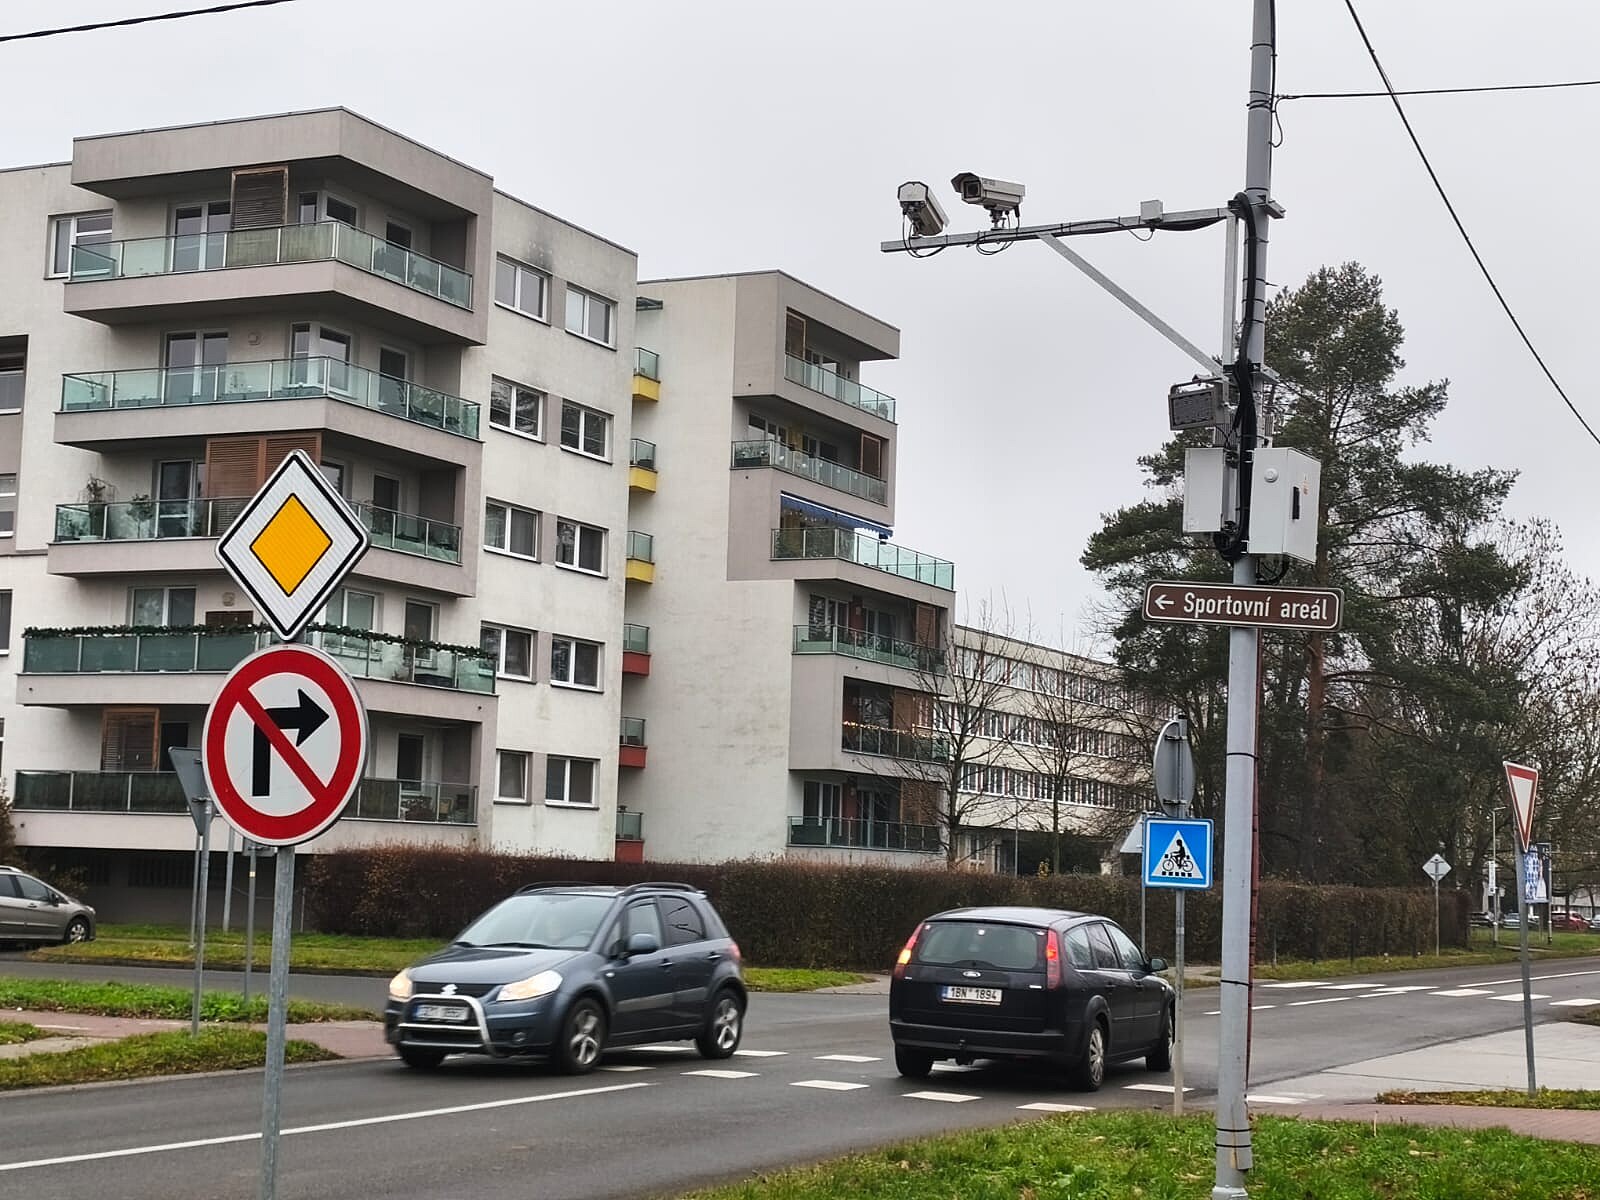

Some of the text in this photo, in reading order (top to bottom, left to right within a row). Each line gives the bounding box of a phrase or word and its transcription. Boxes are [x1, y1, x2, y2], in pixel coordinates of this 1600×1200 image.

[1184, 592, 1328, 620] Sportovní areál
[951, 987, 997, 1000] 1BN 1894
